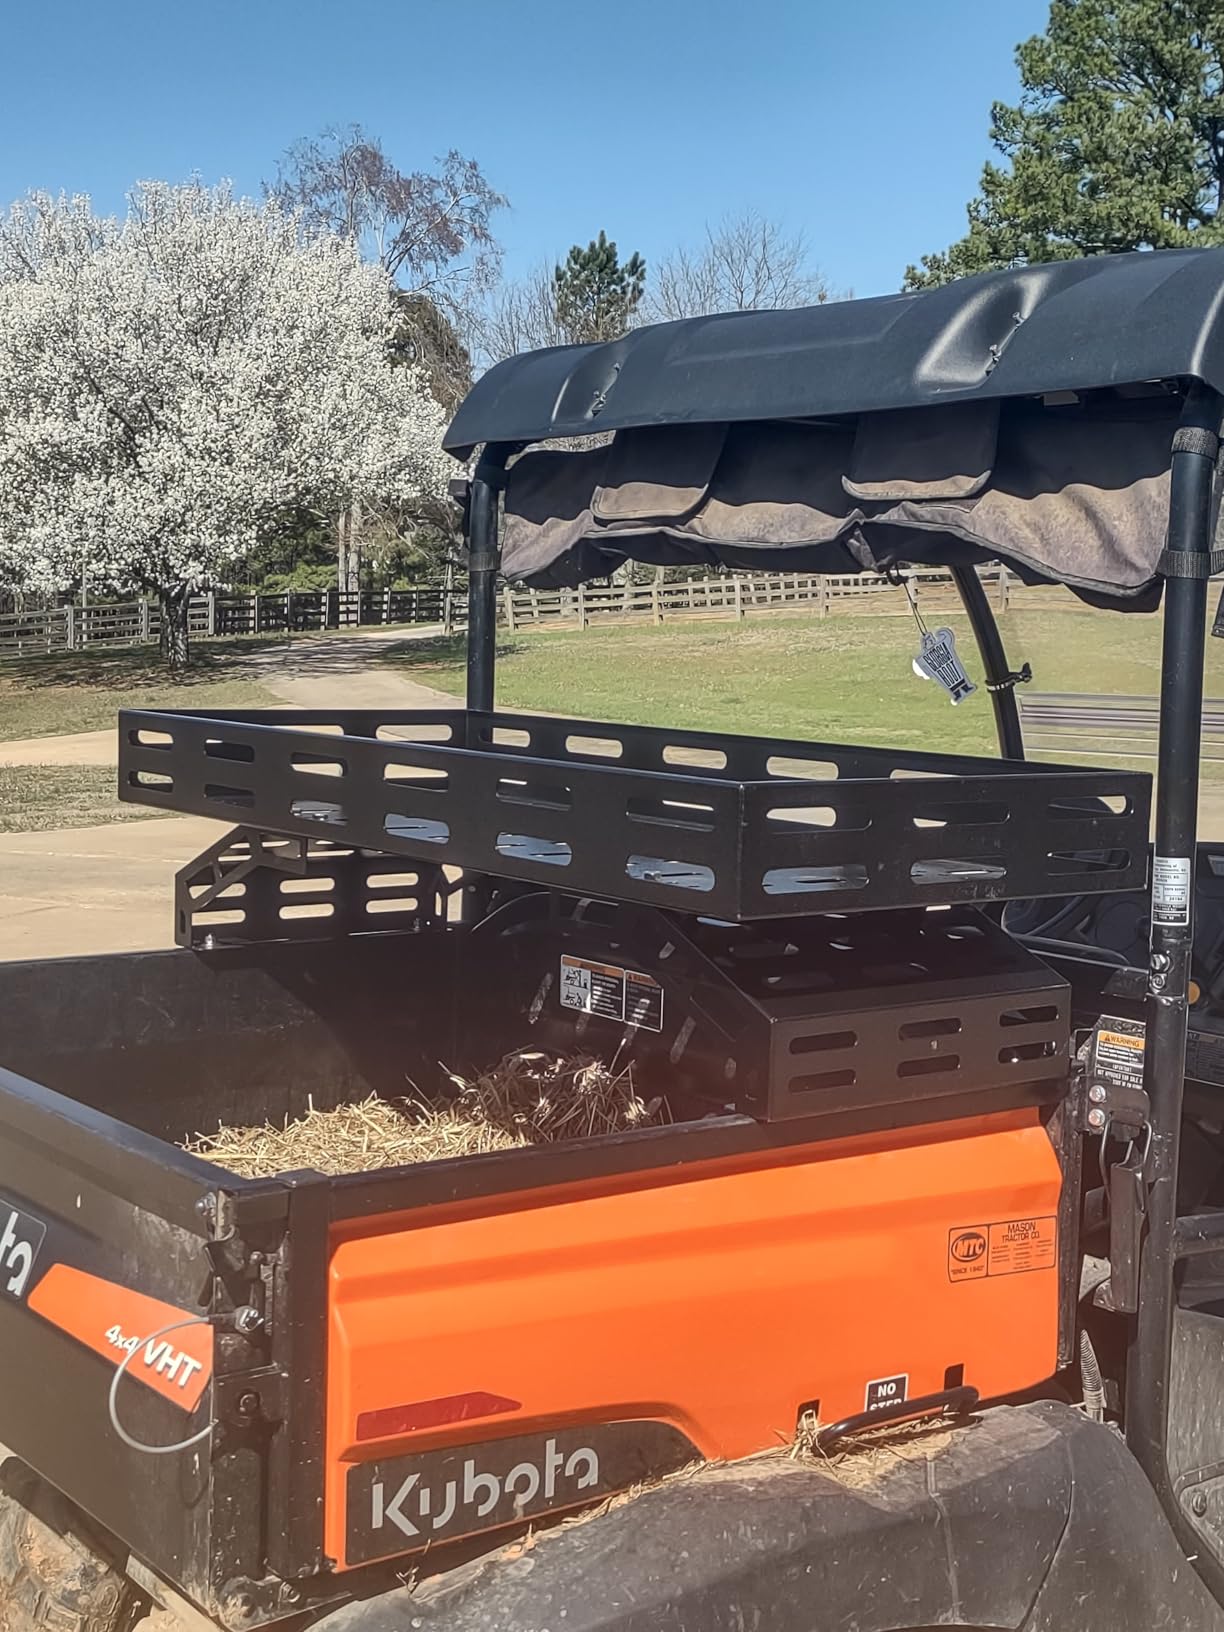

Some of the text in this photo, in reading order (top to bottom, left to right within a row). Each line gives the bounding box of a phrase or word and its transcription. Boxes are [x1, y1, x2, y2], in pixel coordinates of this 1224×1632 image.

[936, 660, 962, 687] BOOT
[1111, 1035, 1140, 1048] WARNING
[1007, 1221, 1036, 1234] MASON
[1001, 1232, 1029, 1243] TRACTOR
[105, 1325, 203, 1387] 4x4 VHT
[877, 1382, 897, 1398] NO
[371, 1438, 599, 1537] Kubota
